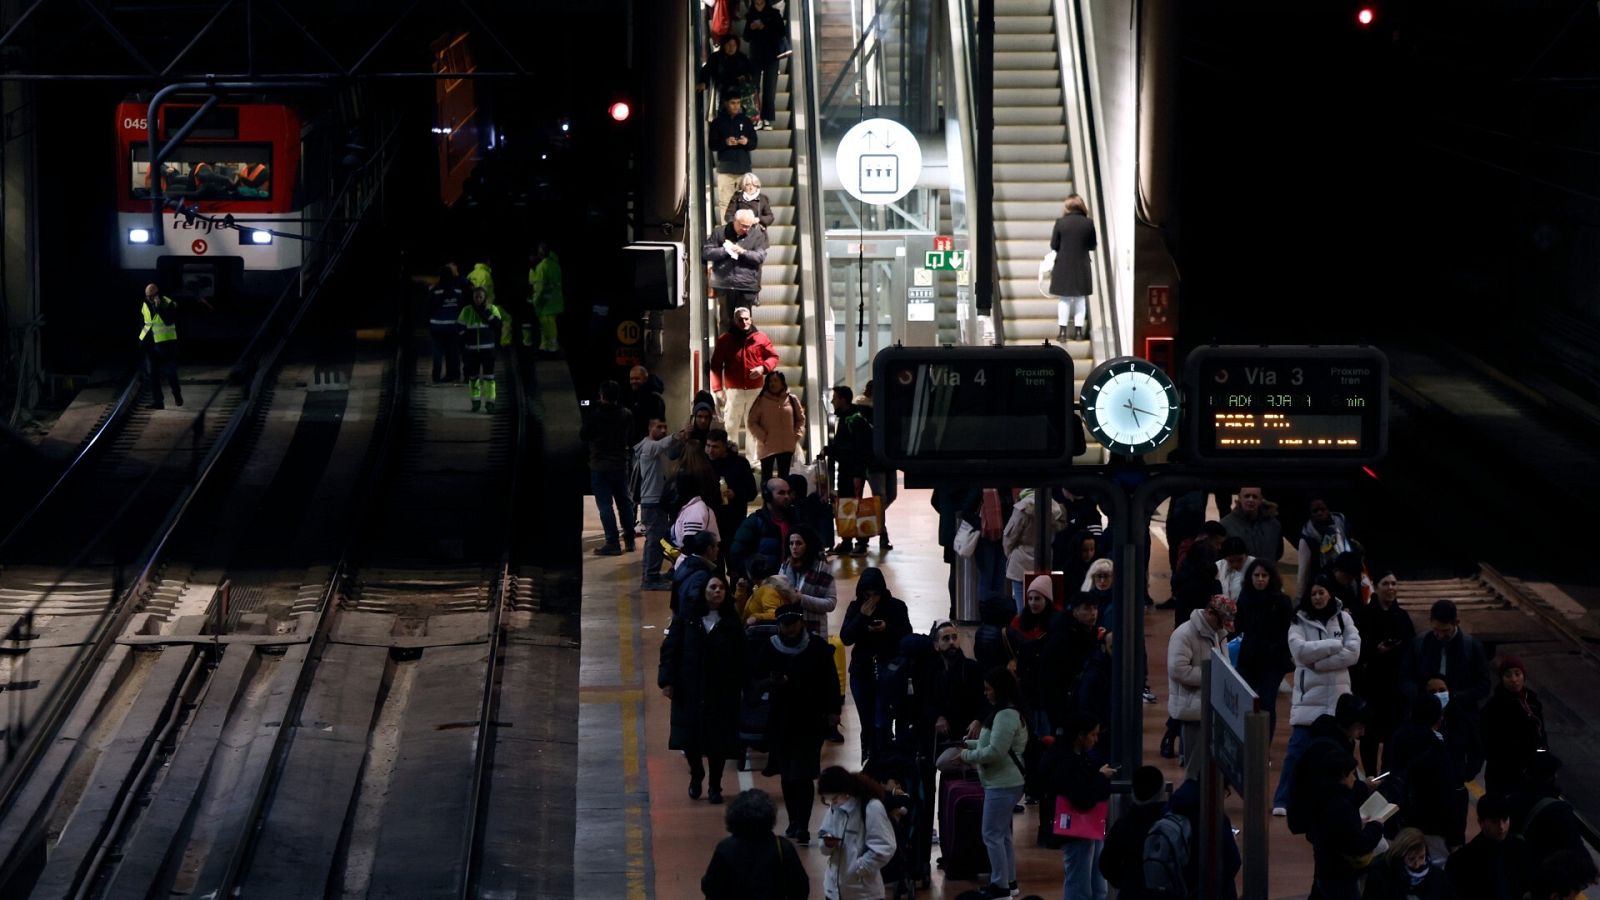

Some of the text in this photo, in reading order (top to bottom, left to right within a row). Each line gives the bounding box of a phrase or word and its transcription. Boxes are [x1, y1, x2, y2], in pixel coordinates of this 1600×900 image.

[173, 215, 225, 235] renfe
[622, 326, 637, 338] 10
[973, 368, 986, 386] 4
[1025, 377, 1046, 385] tren
[1291, 367, 1304, 386] 3
[1340, 376, 1361, 385] tren
